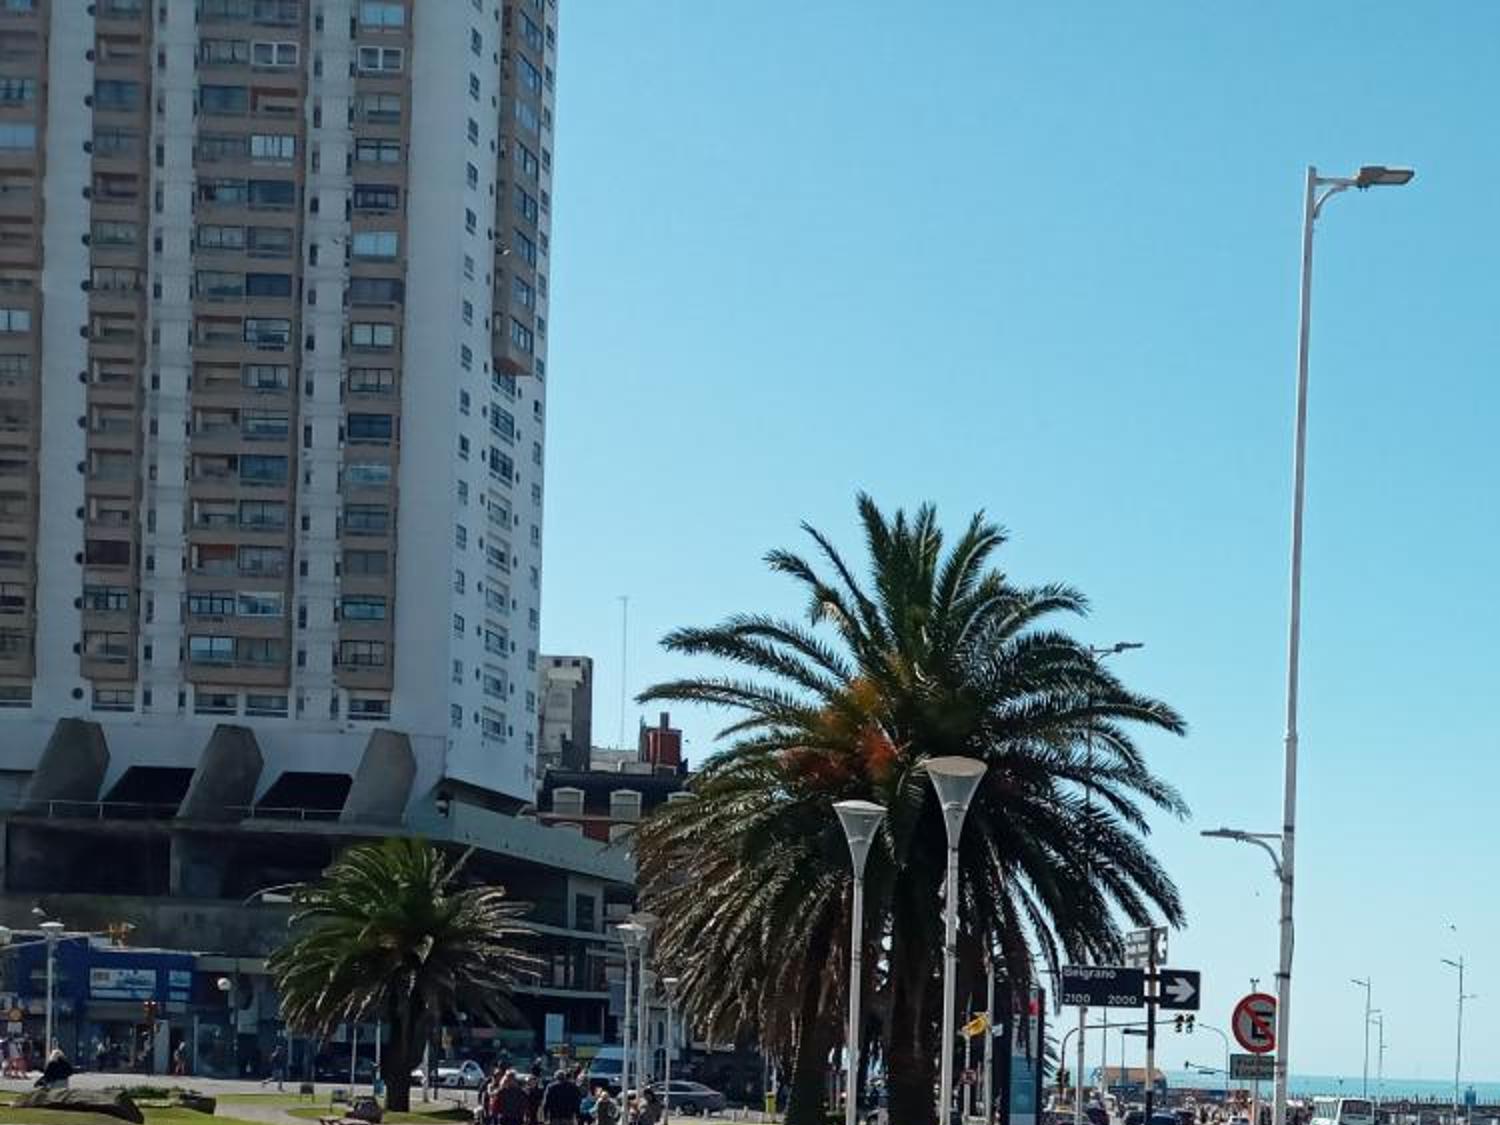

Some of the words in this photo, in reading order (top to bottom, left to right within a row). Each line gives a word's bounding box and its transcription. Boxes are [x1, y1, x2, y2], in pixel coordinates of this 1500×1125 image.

[1063, 967, 1116, 980] Belgrano
[1064, 993, 1091, 1004] 2100
[1107, 994, 1137, 1006] 2000
